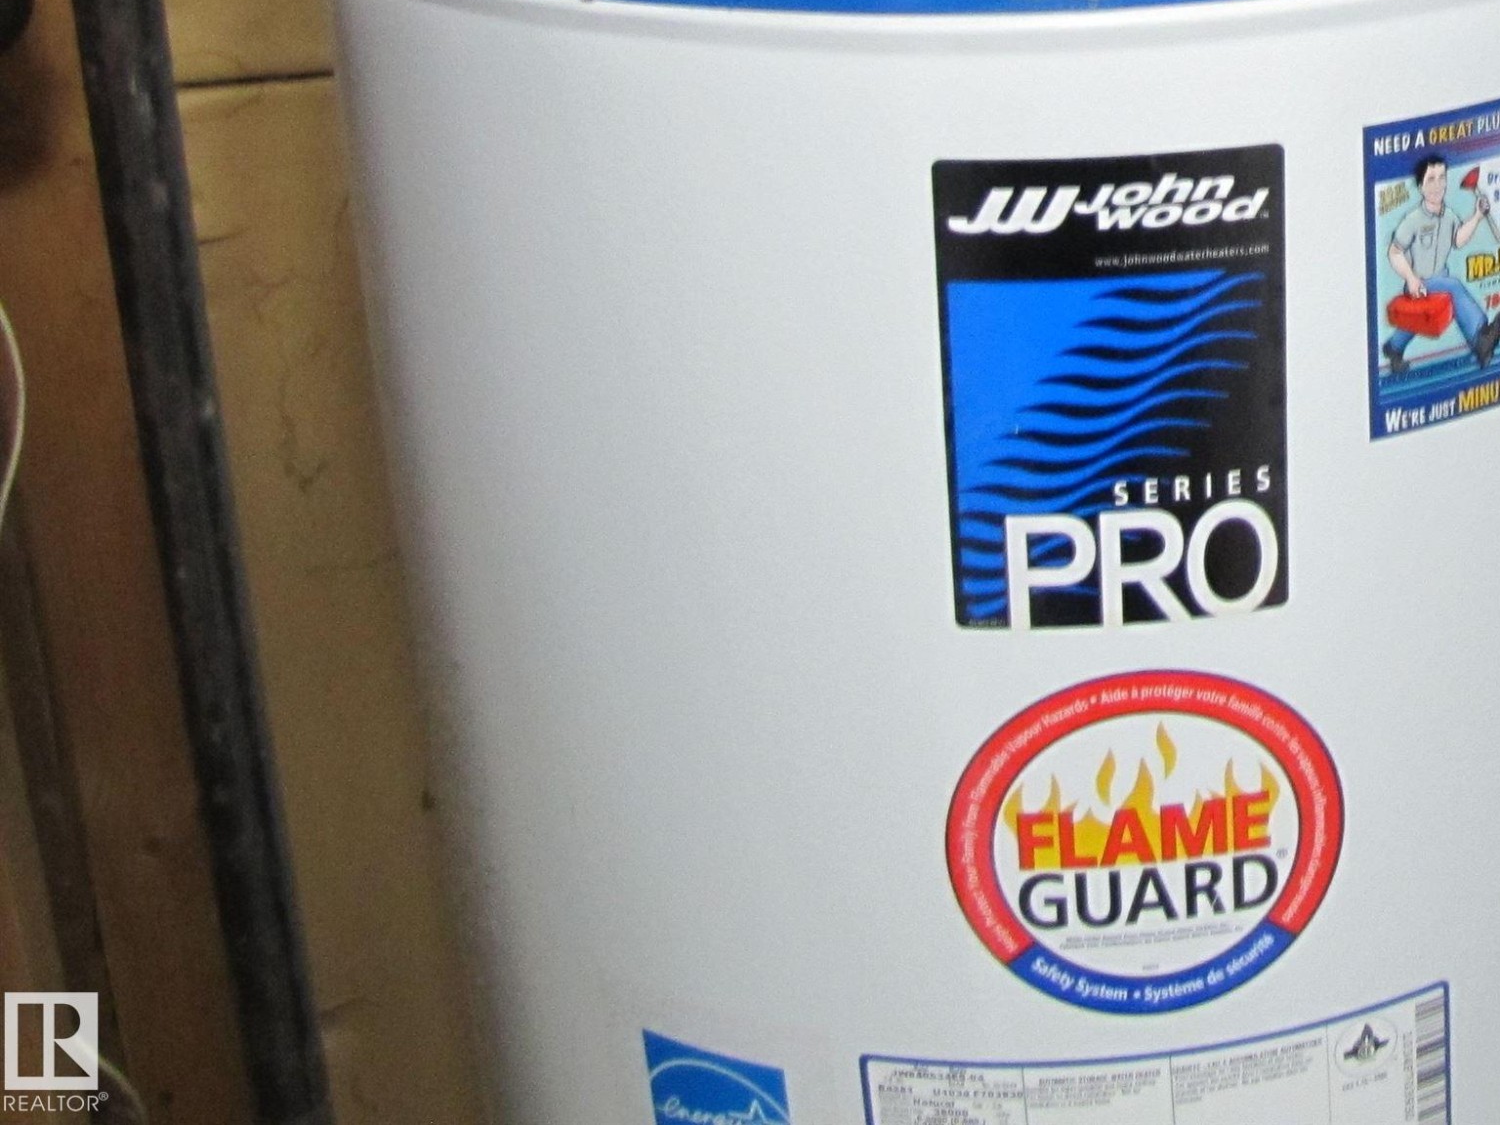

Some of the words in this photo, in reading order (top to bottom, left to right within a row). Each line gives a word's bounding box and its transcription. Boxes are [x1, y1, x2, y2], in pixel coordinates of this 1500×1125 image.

[1374, 136, 1411, 156] NEED
[1415, 130, 1425, 148] A
[1429, 121, 1474, 145] GREAT
[1095, 244, 1270, 267] www.johnwoodwaterheaters.com
[1113, 465, 1271, 506] SERIES
[1005, 499, 1279, 630] PRO
[1041, 699, 1089, 727] Hazards
[1100, 690, 1128, 705] Aide
[1196, 688, 1226, 705] votre
[1016, 791, 1271, 871] FLAME
[1018, 854, 1279, 930] GUARD
[1031, 957, 1074, 991] Safety
[1075, 976, 1128, 1002] System
[1207, 966, 1225, 986] de
